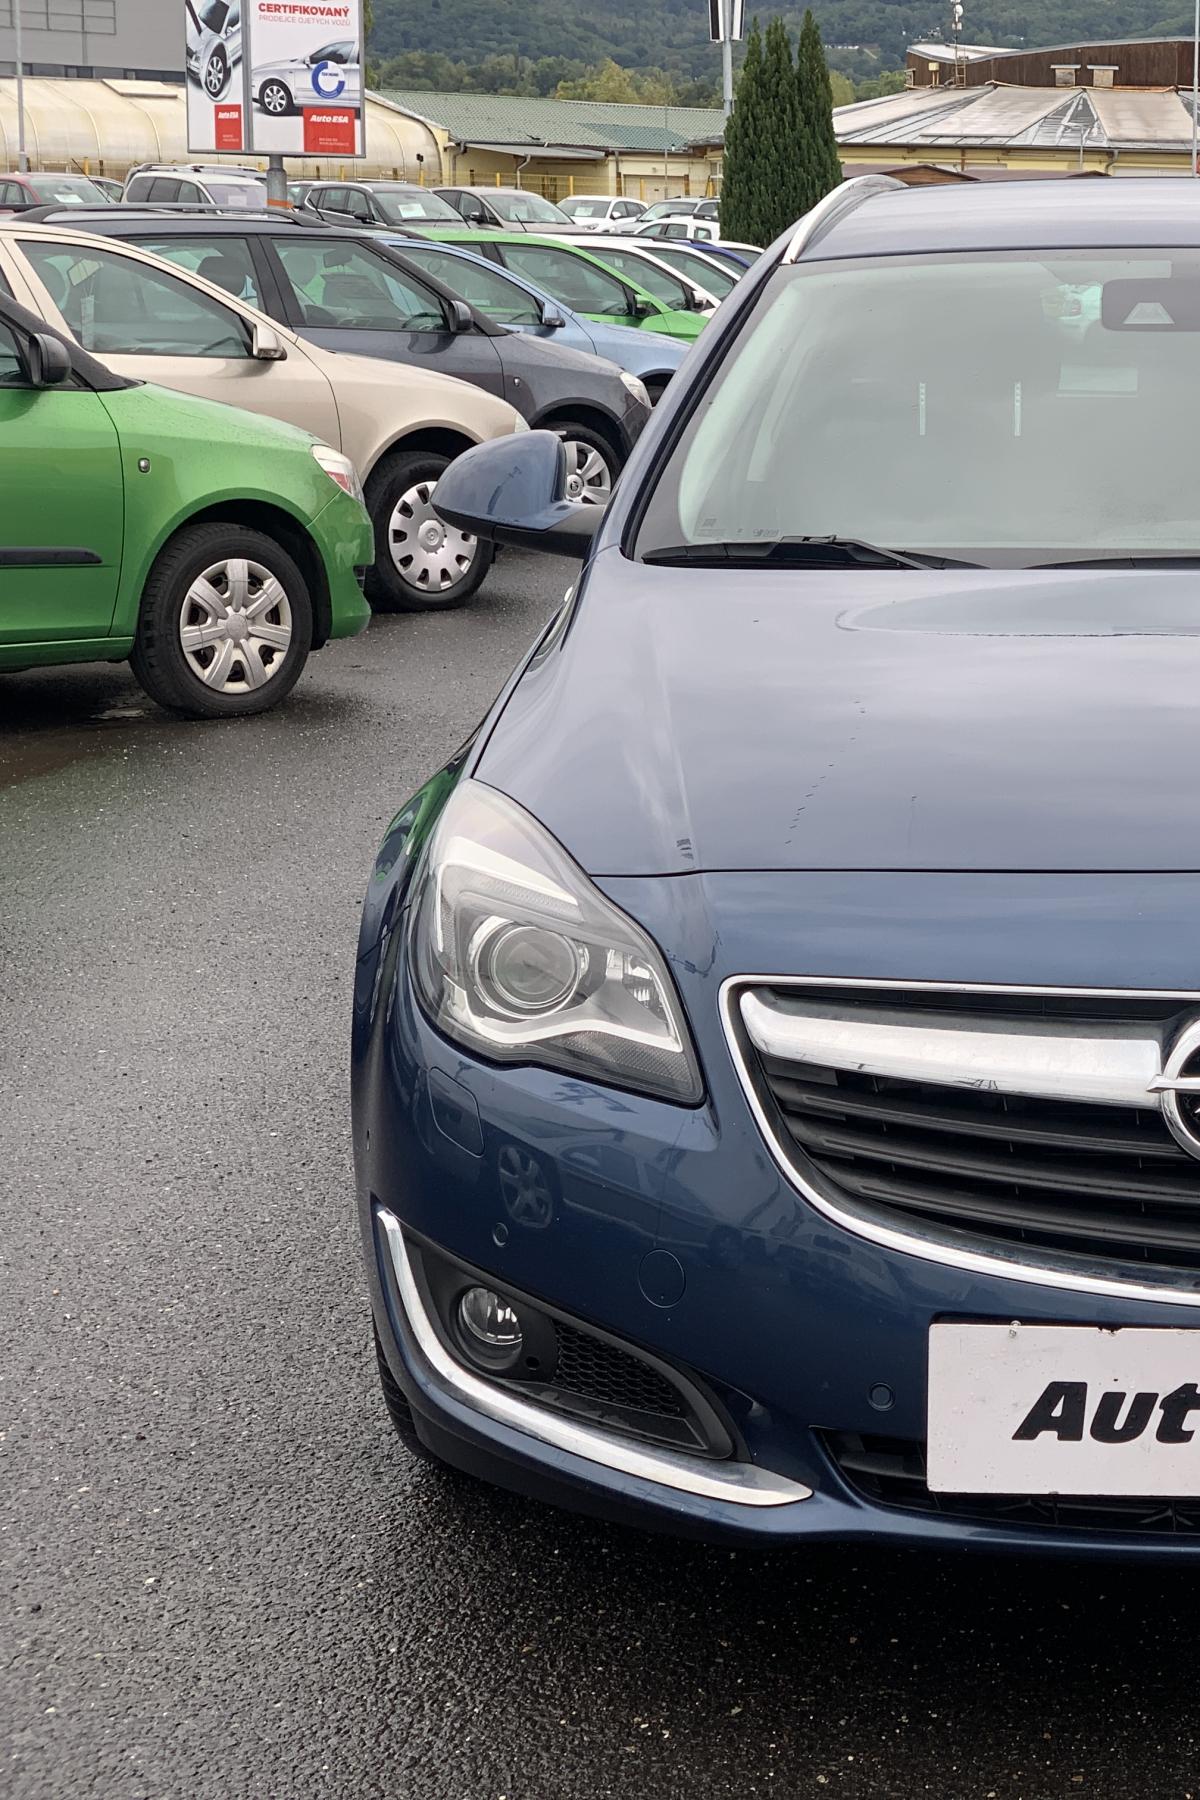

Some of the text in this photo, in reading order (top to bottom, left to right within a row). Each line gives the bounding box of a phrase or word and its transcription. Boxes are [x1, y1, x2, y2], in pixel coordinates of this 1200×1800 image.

[258, 3, 350, 17] CERTIFIKOVANÝ
[258, 15, 297, 24] PRODEJCE
[298, 16, 330, 25] OJETÝCH
[310, 114, 349, 124] Auto ESA
